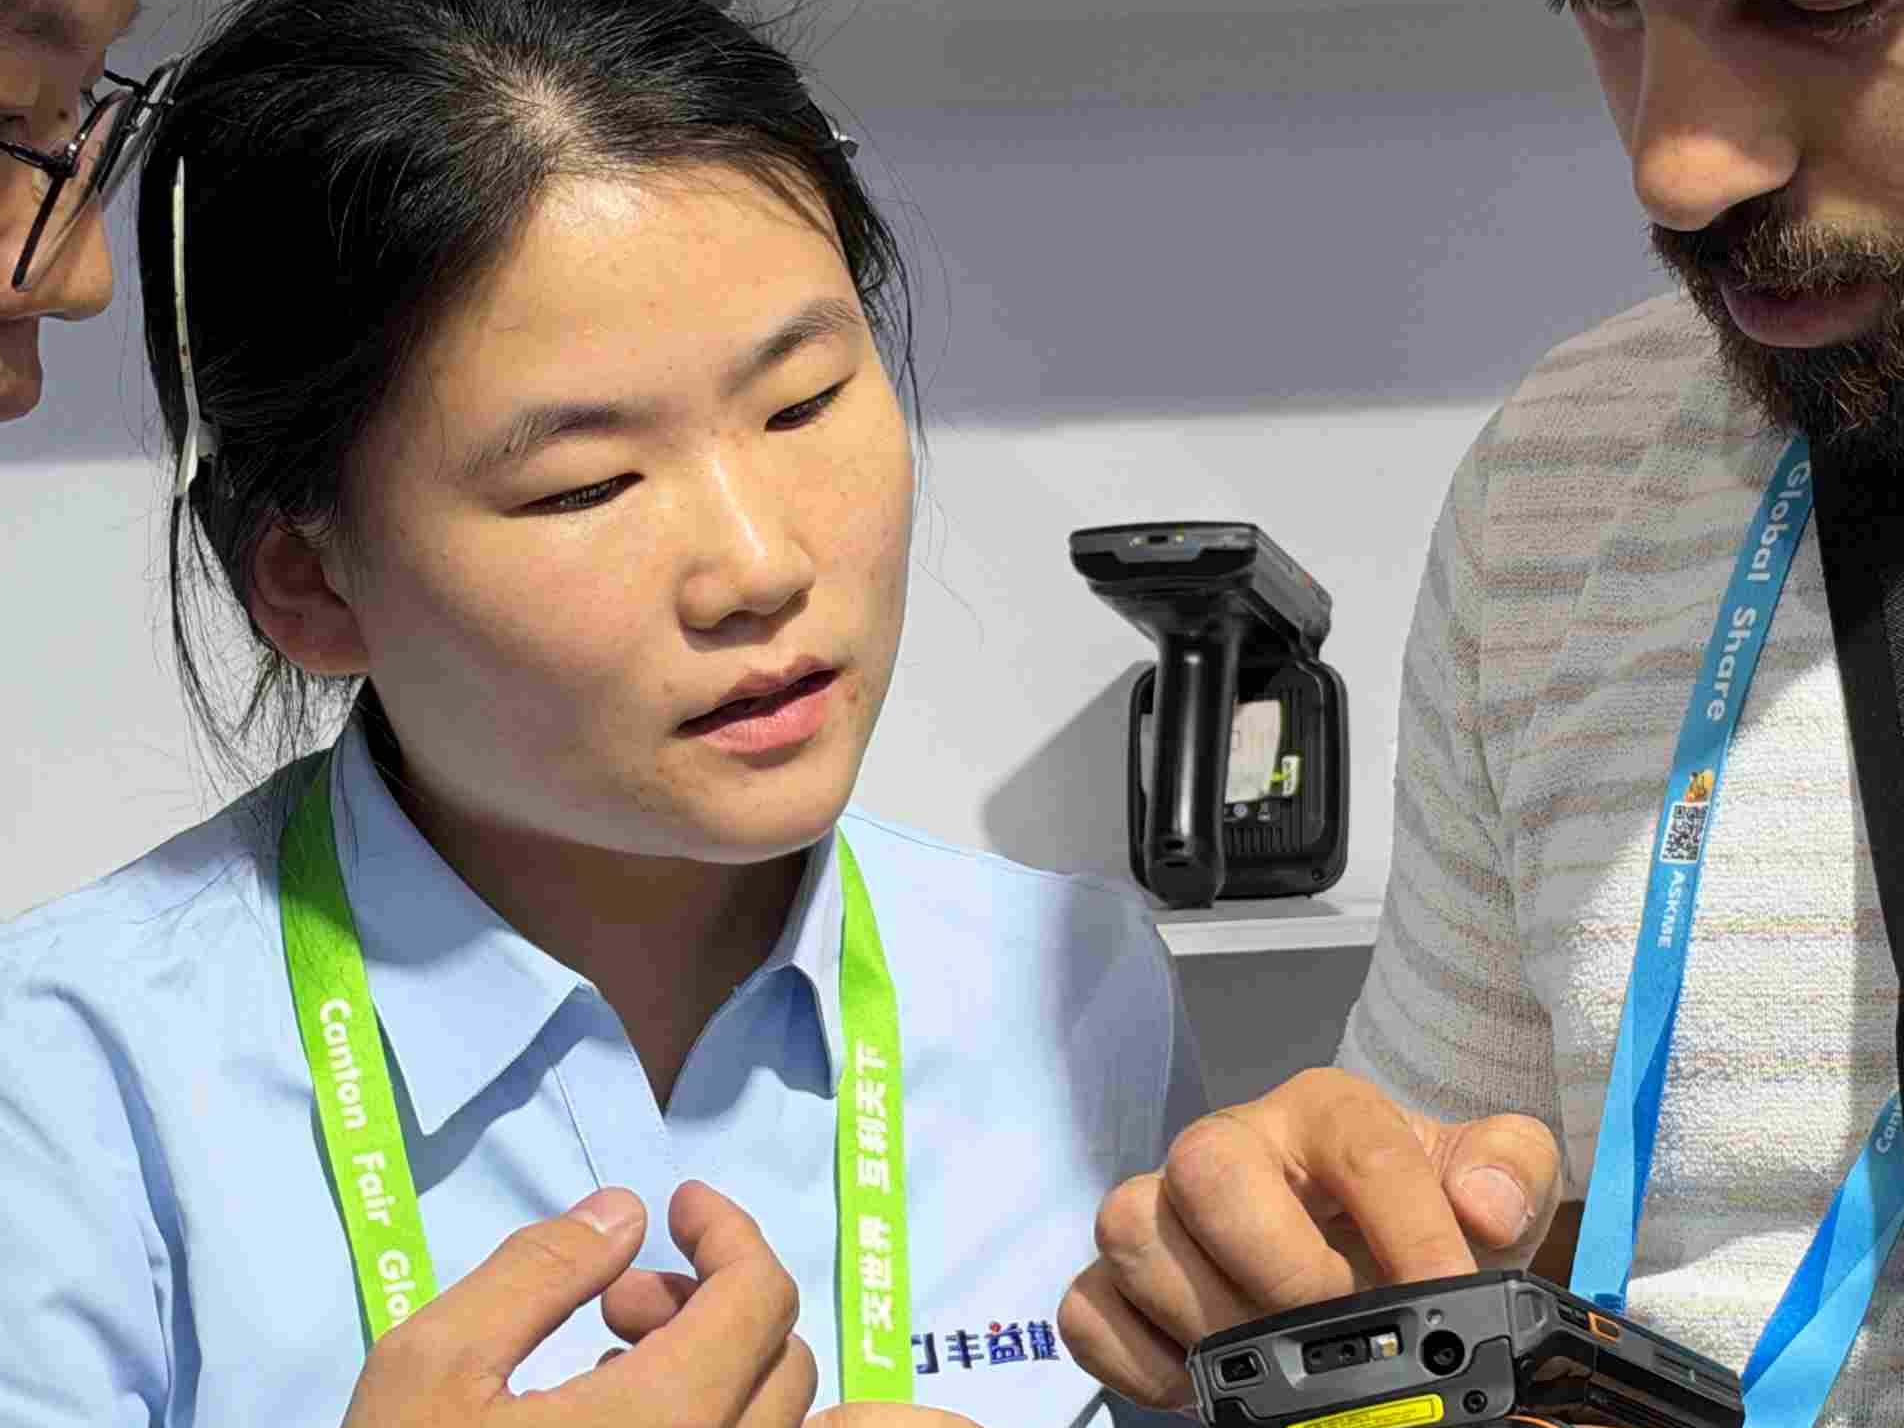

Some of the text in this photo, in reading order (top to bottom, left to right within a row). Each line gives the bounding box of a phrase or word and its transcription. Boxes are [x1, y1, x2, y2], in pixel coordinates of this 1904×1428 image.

[1705, 461, 1811, 723] Global Share
[320, 998, 416, 1328] Canton Fair Glo
[856, 1037, 894, 1370] 广交世界 互利天下
